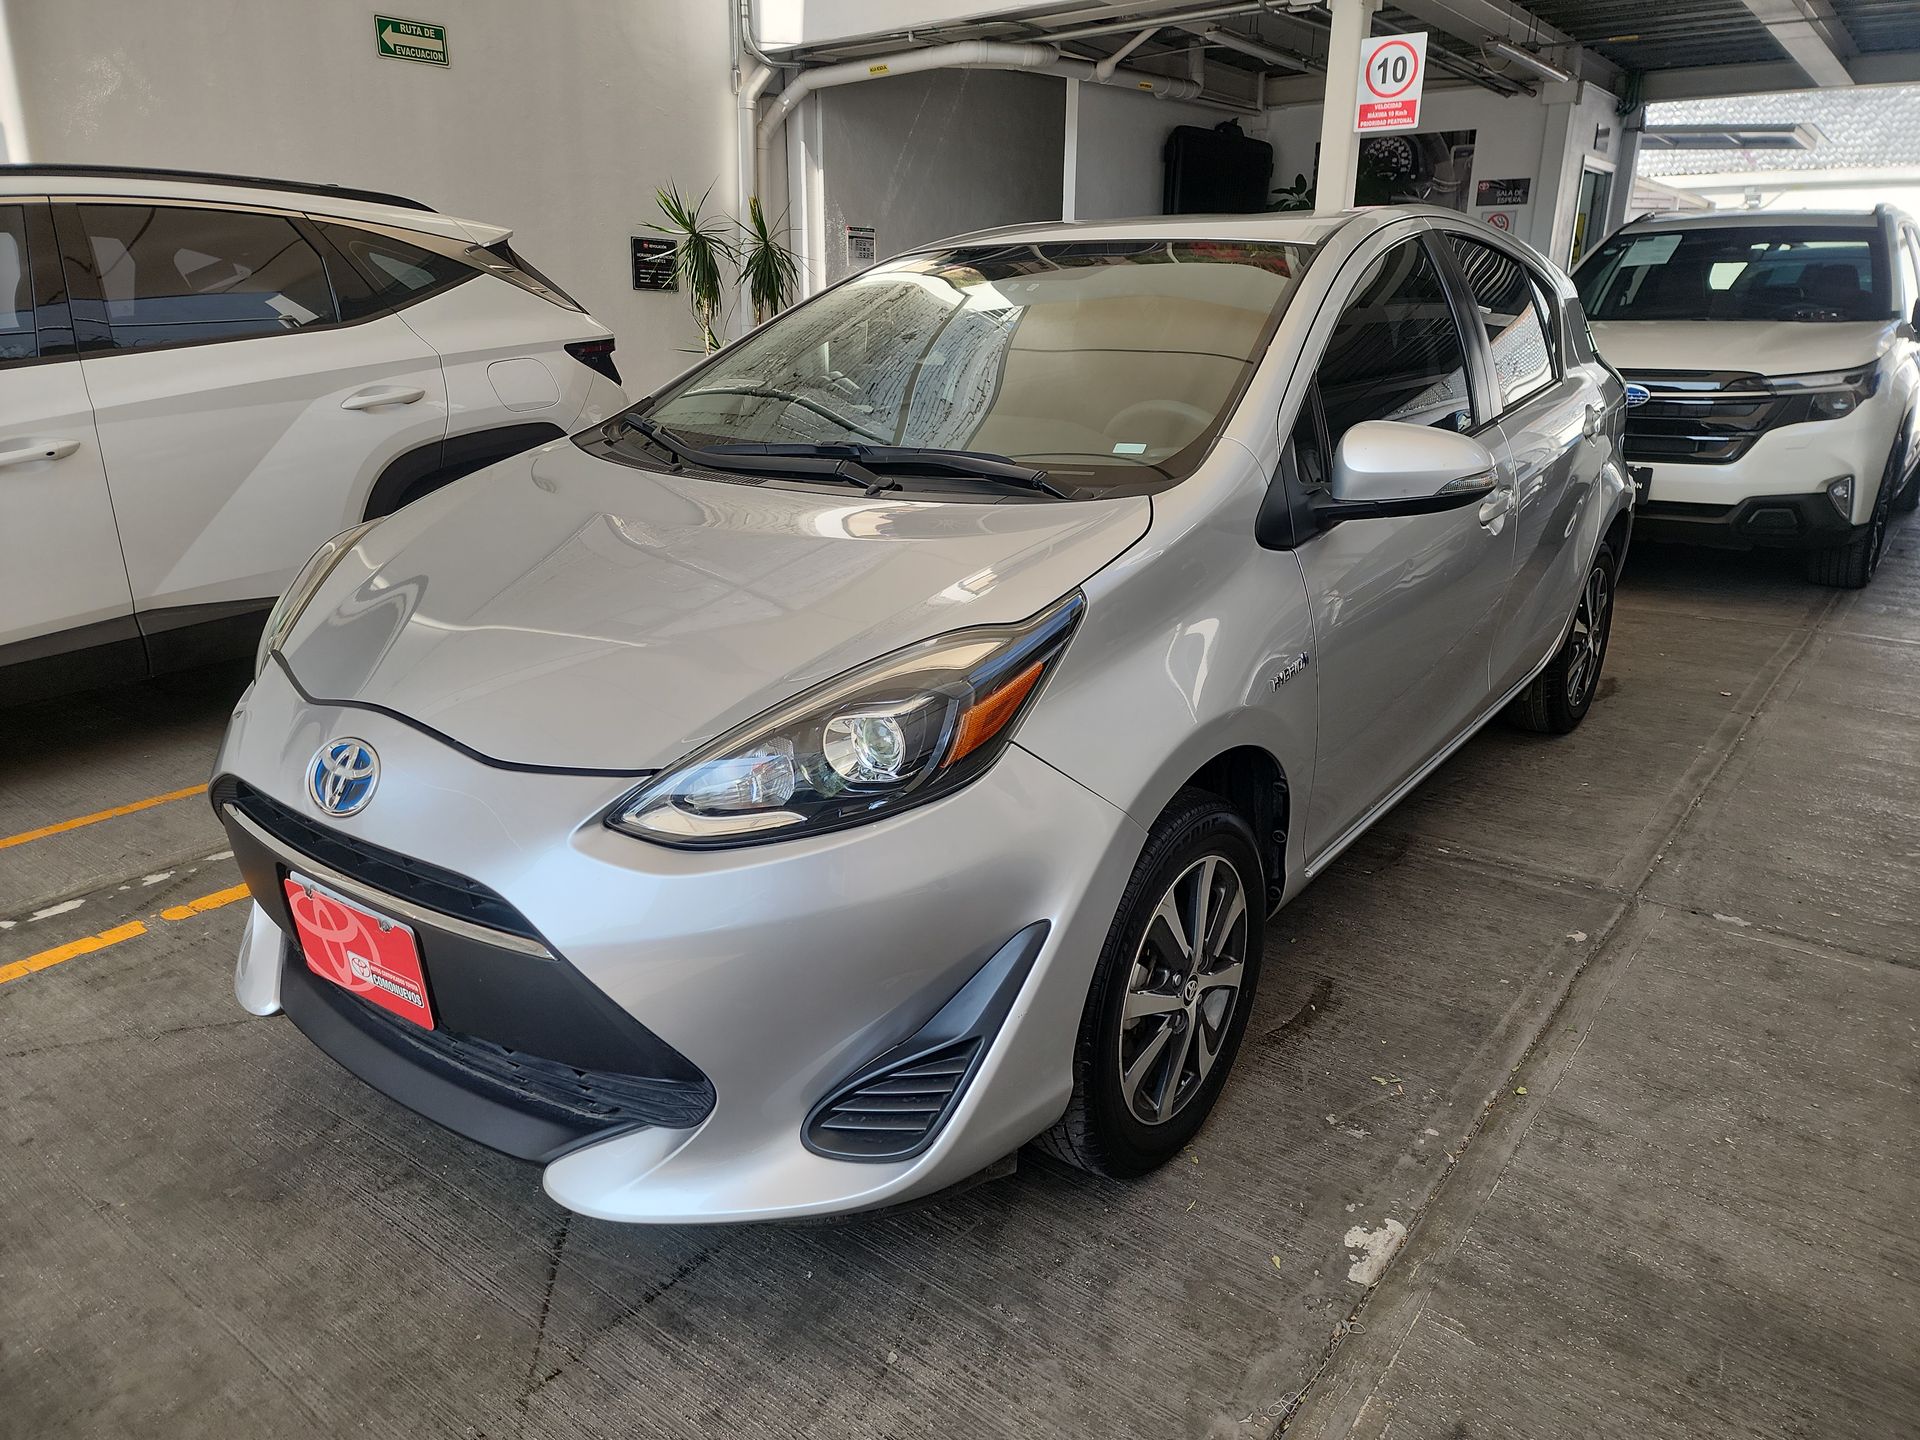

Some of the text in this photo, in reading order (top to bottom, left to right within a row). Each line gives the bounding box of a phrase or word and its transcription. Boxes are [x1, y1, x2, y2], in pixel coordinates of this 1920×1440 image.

[400, 24, 435, 38] RUTA DE
[396, 45, 444, 61] EVACUACION
[1377, 56, 1407, 84] 10
[1374, 102, 1403, 110] VELOCIDAD
[1360, 117, 1413, 127] PRIORIDAD PEATONAL
[373, 974, 421, 1004] COMONUEVOS
